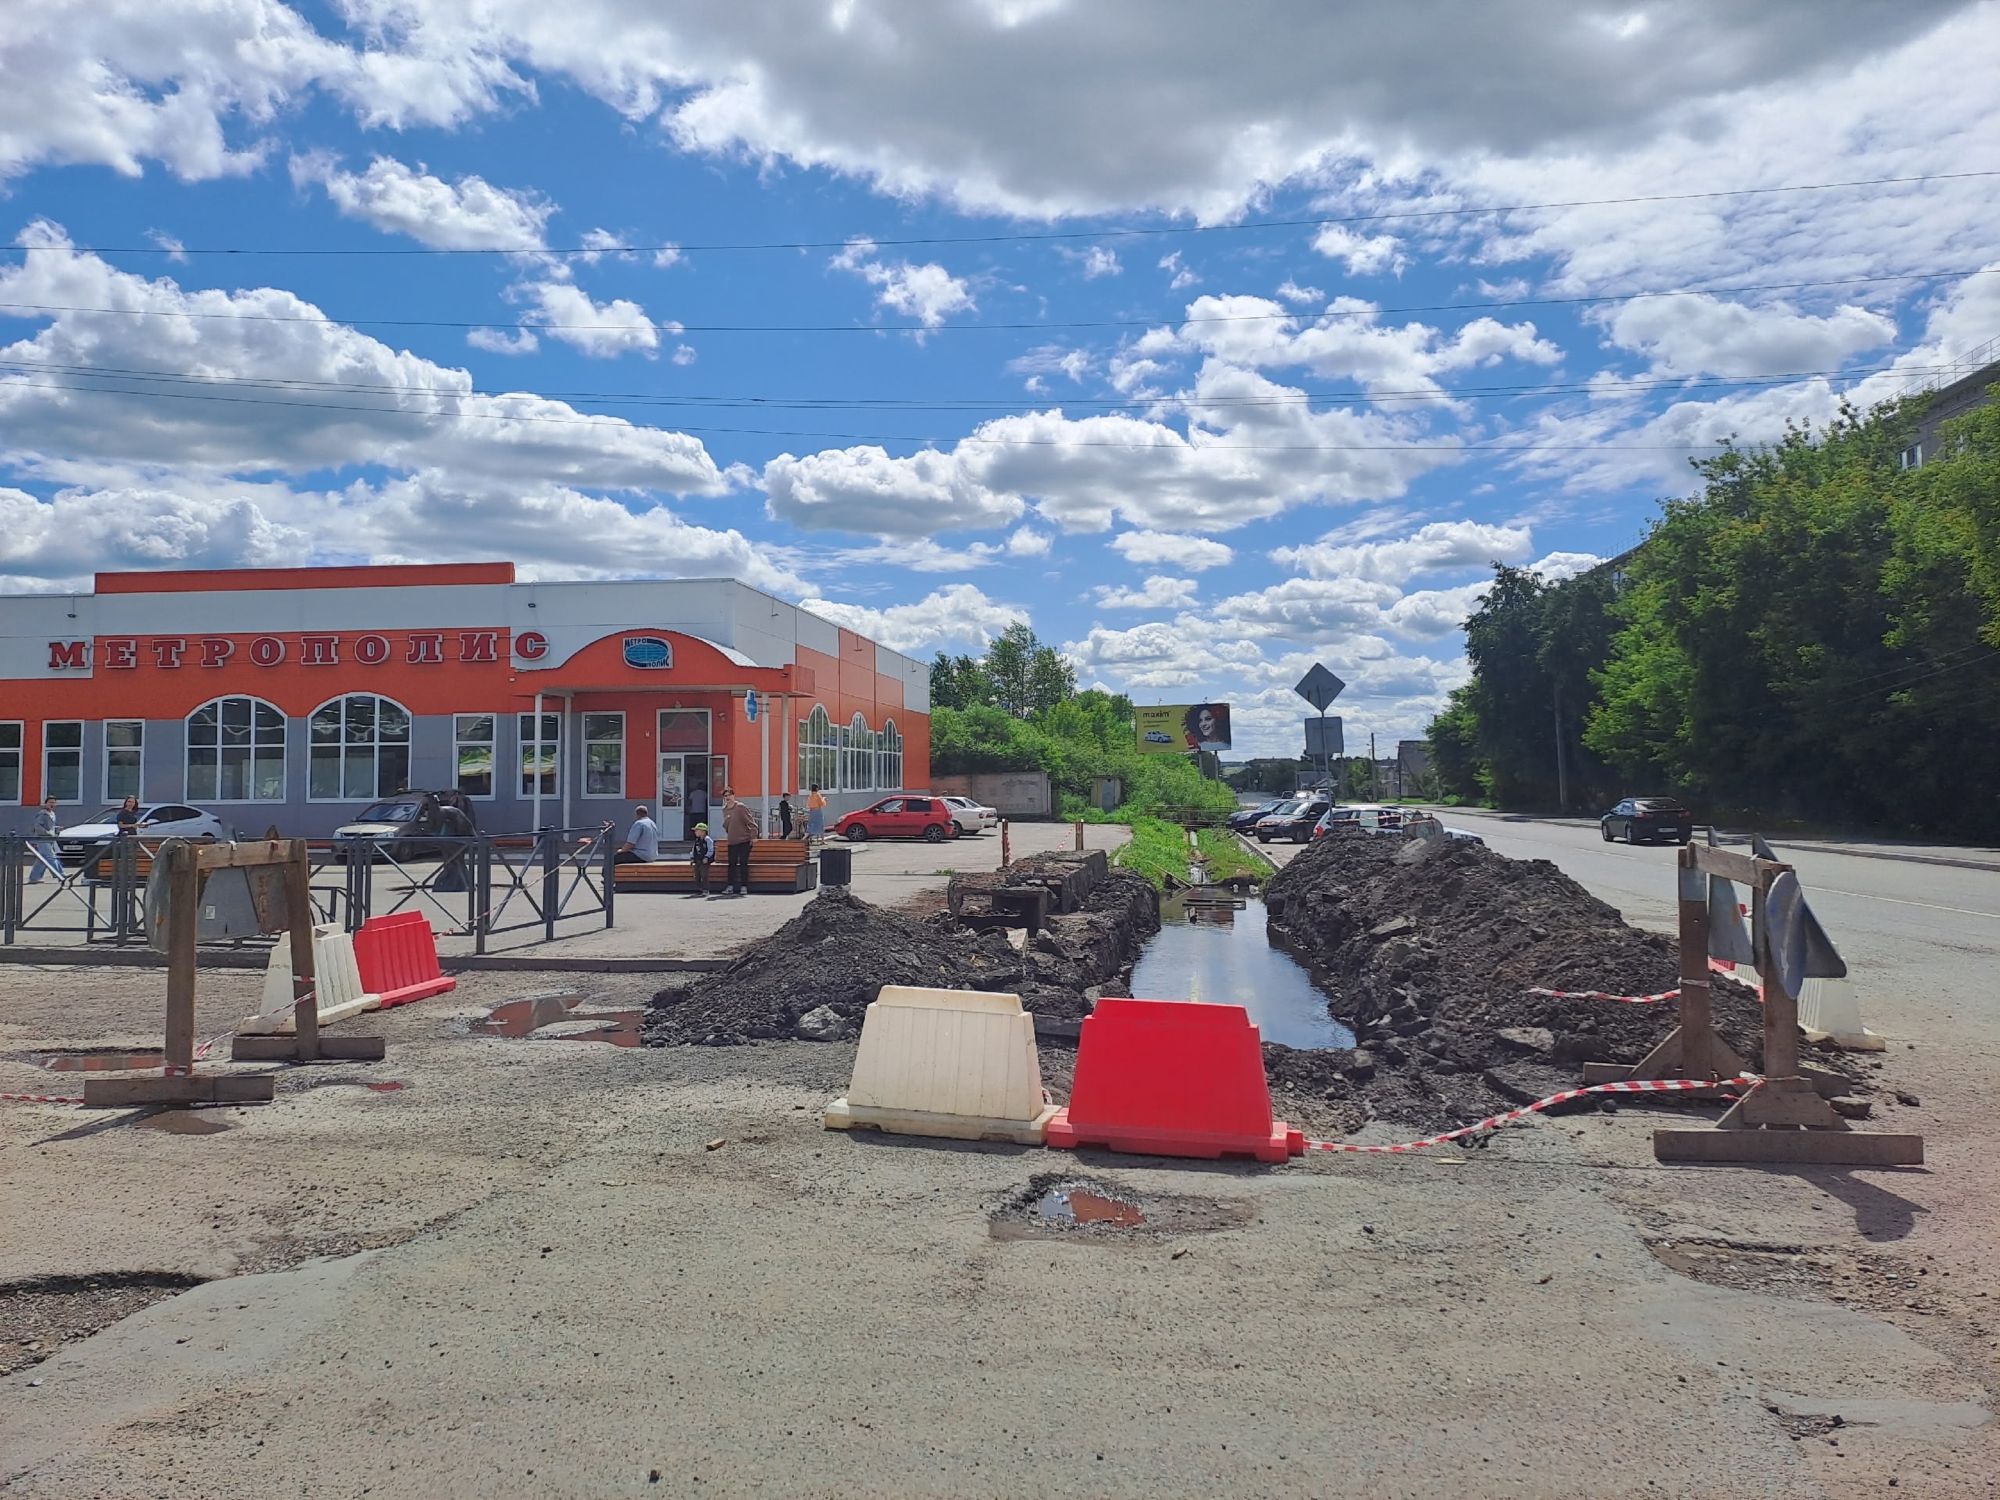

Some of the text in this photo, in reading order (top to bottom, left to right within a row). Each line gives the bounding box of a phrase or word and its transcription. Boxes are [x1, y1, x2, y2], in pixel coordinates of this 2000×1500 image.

[48, 631, 550, 669] МЕТРОПОЛИС
[624, 638, 646, 651] МЕТРО
[1143, 710, 1170, 718] maxim
